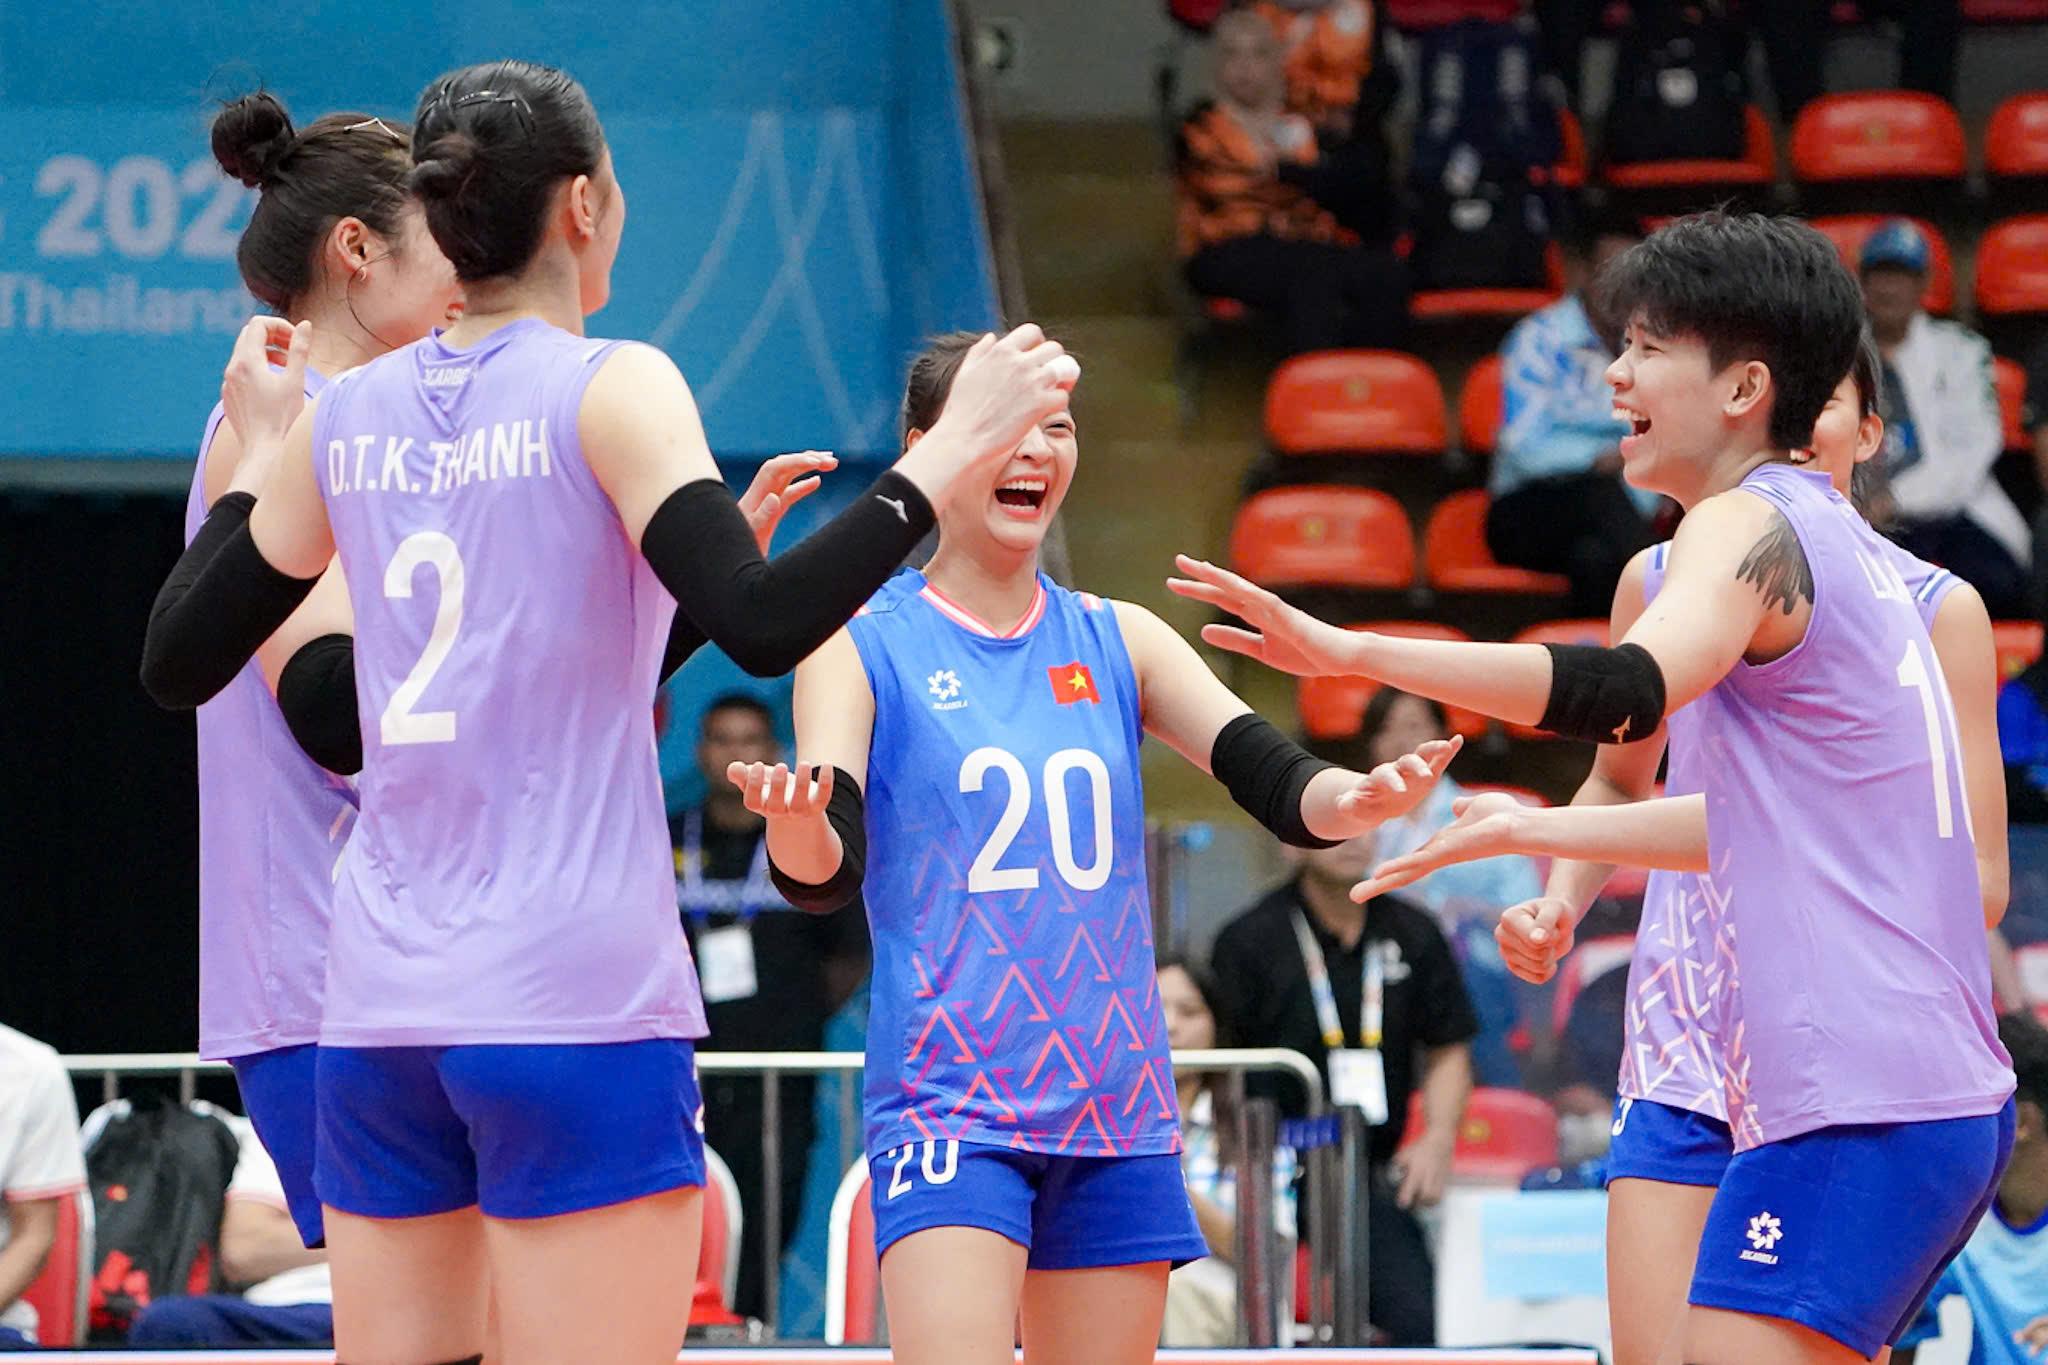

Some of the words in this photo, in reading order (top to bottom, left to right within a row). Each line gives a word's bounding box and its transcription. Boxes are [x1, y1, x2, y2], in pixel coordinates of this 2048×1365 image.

[38, 155, 260, 258] 202
[380, 531, 465, 746] 2
[958, 746, 1114, 894] 20
[887, 1139, 960, 1201] 20
